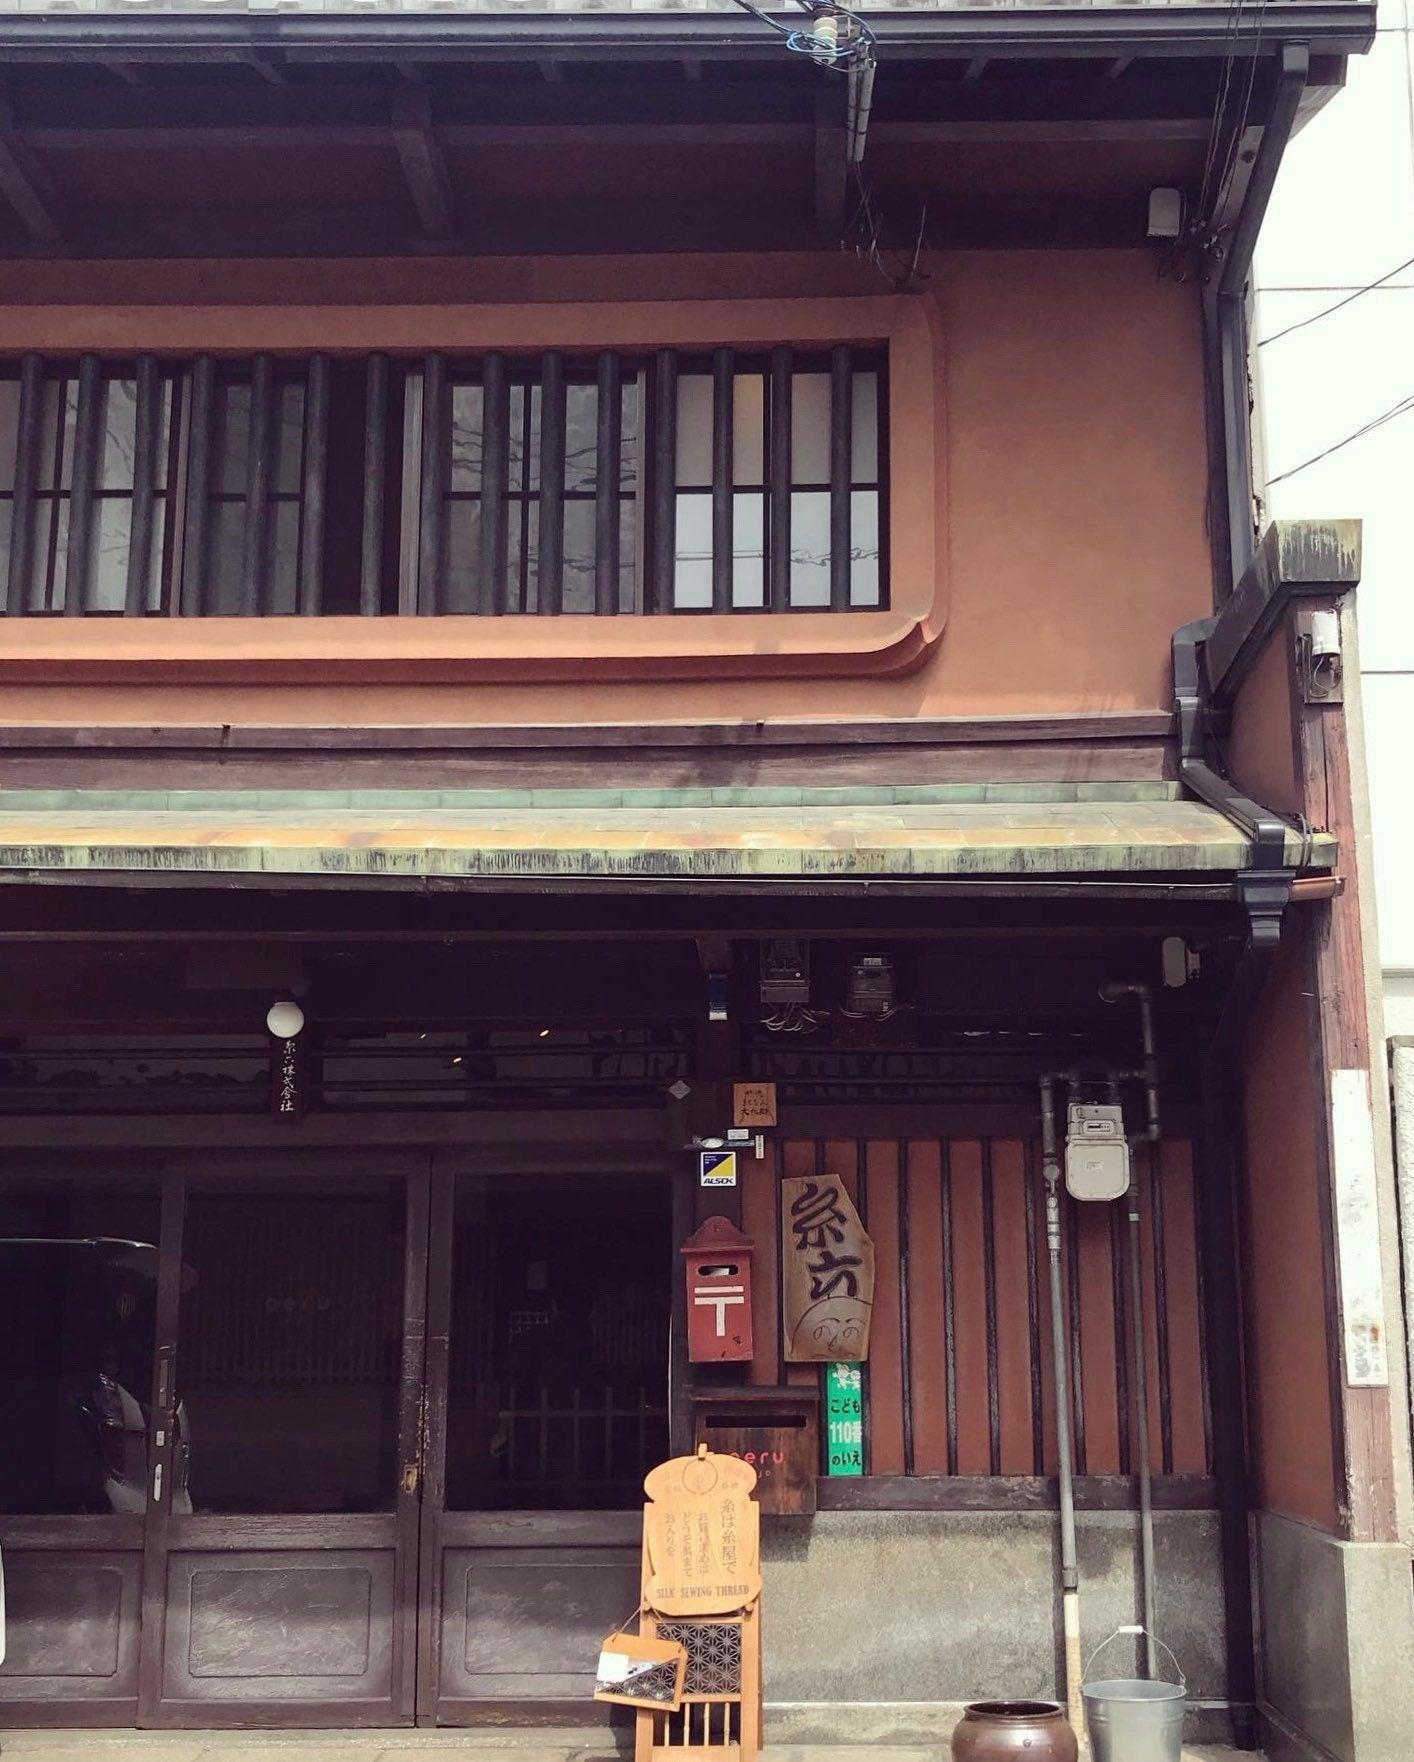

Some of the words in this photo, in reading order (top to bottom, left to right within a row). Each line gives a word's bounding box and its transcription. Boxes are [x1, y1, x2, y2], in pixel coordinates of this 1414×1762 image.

[791, 1182, 863, 1299] 糸六
[830, 1397, 860, 1414] こども
[731, 1452, 784, 1464] eru
[831, 1450, 861, 1466] のいえ
[656, 1588, 675, 1599] SILK
[680, 1586, 712, 1598] SEWING
[715, 1584, 750, 1597] THREAD
